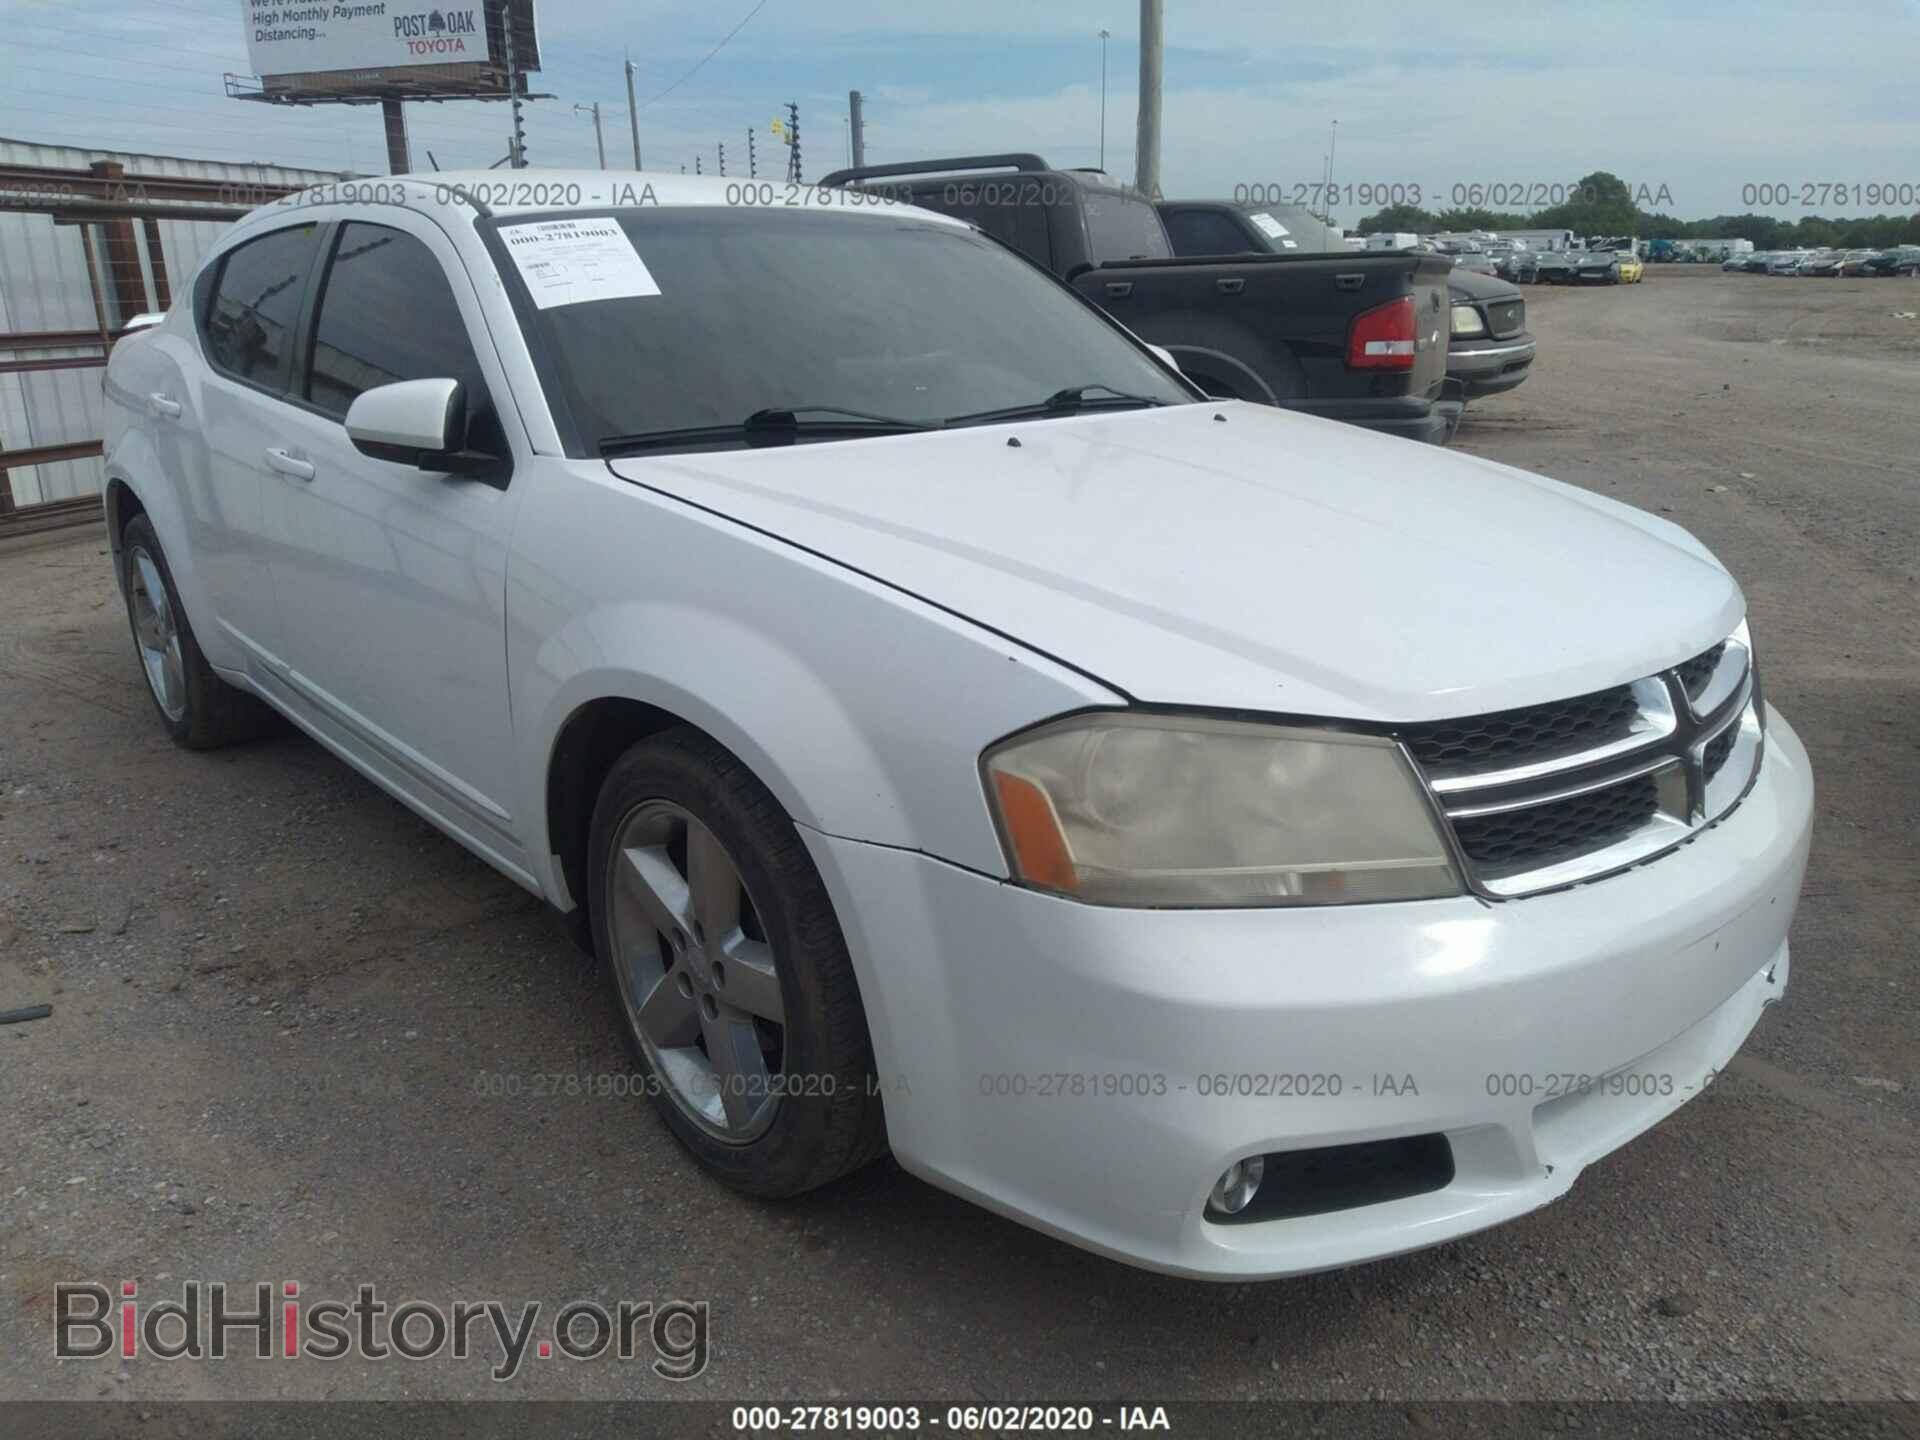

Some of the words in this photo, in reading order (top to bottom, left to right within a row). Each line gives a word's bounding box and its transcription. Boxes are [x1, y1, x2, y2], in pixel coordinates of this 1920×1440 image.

[252, 10, 279, 26] High
[282, 7, 329, 22] Monthly
[333, 2, 385, 20] Payment
[393, 14, 426, 37] POST
[447, 10, 475, 33] OAK
[255, 25, 327, 42] Distancing...
[407, 38, 465, 54] TOYOTA
